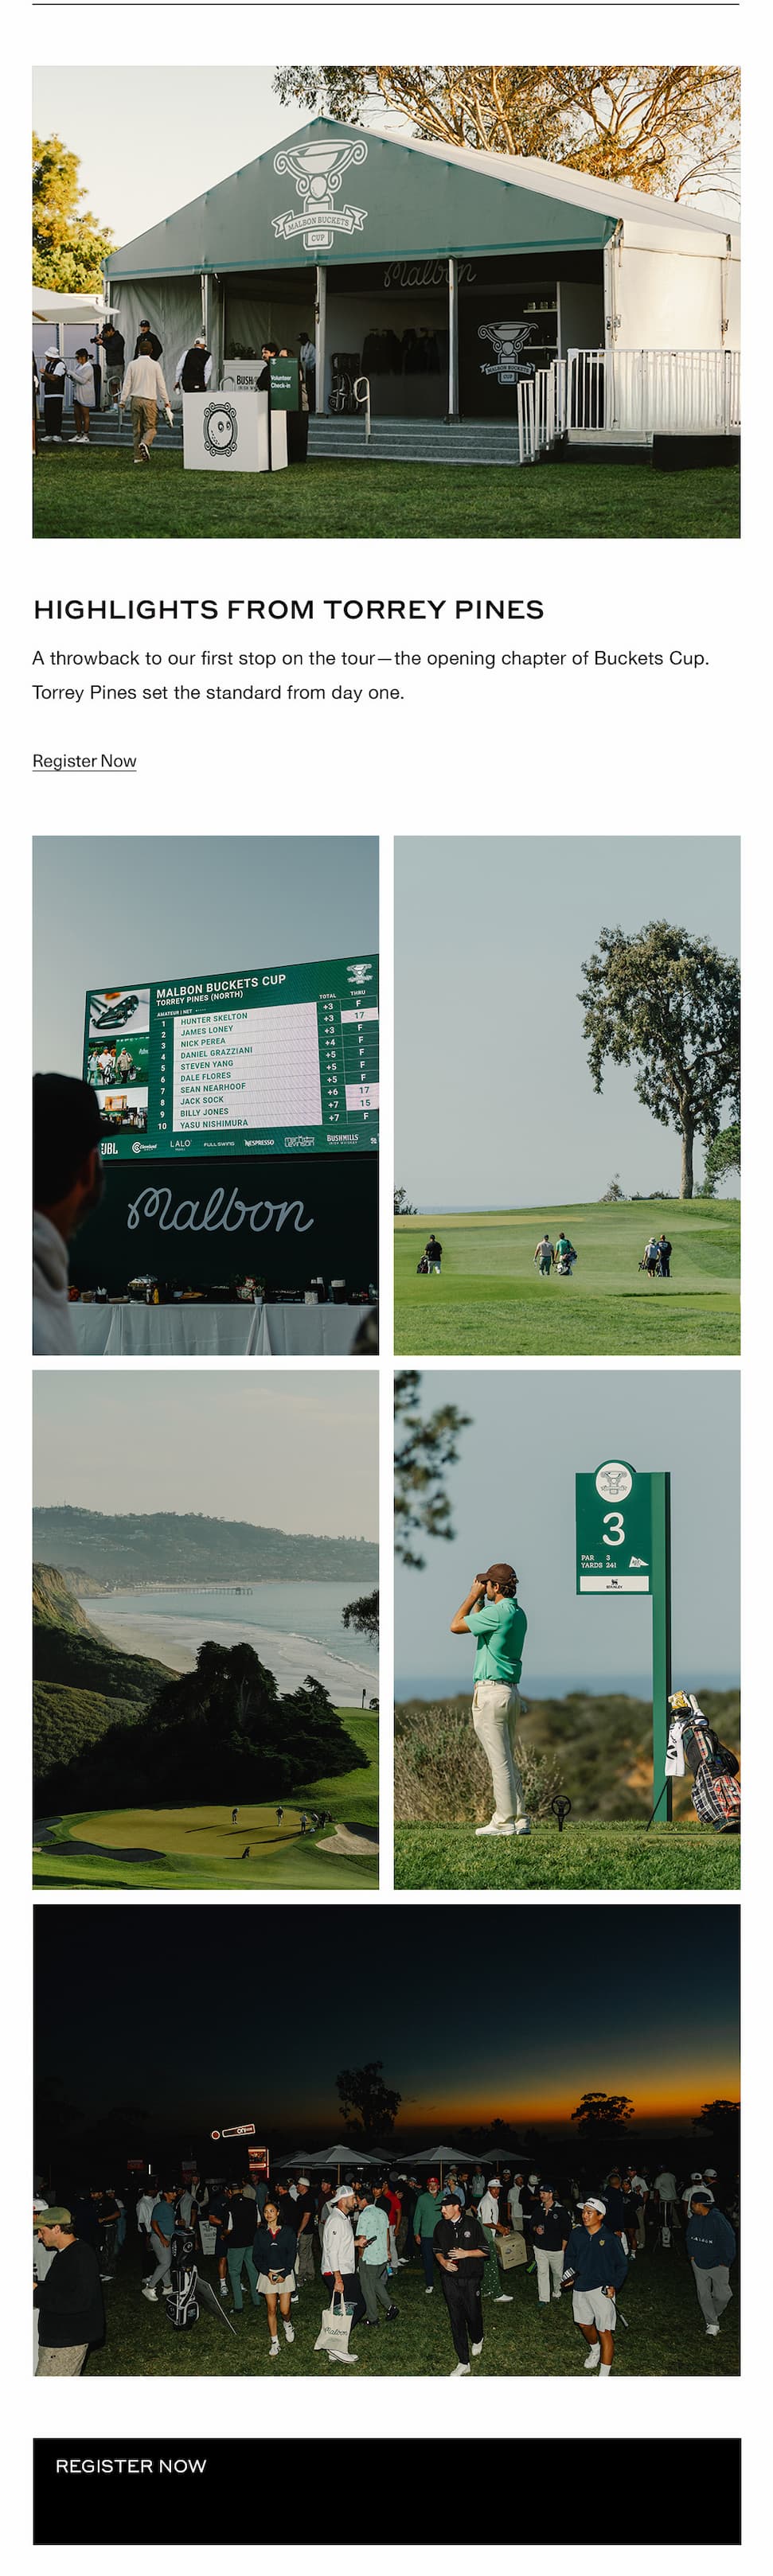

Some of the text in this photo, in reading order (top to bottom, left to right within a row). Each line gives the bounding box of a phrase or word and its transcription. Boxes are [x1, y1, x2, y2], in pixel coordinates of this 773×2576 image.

[287, 216, 349, 232] MALBON BUCKETS
[236, 375, 257, 385] BUSH
[156, 974, 287, 999] MALBON BUCKETS CUP
[156, 990, 244, 1007] TORREY PINES (NORTH)
[181, 1015, 211, 1026] HUNTER
[213, 1012, 248, 1022] SKELTON
[181, 1027, 206, 1036] JAMES
[209, 1025, 233, 1034] LONEY
[181, 1039, 199, 1048] NICK
[201, 1037, 226, 1046] PEREA
[181, 1050, 208, 1059] DANIEL
[210, 1046, 252, 1057] GRAZZIANI
[181, 1062, 210, 1070] STEVEN
[202, 1071, 231, 1081] FLORES
[203, 1082, 246, 1092] NEARHOOF
[180, 1120, 200, 1129] YASU
[202, 1119, 248, 1128] NISHIMURA
[101, 1142, 119, 1155] JBL
[127, 1187, 314, 1233] Malbon
[602, 1512, 626, 1546] 3
